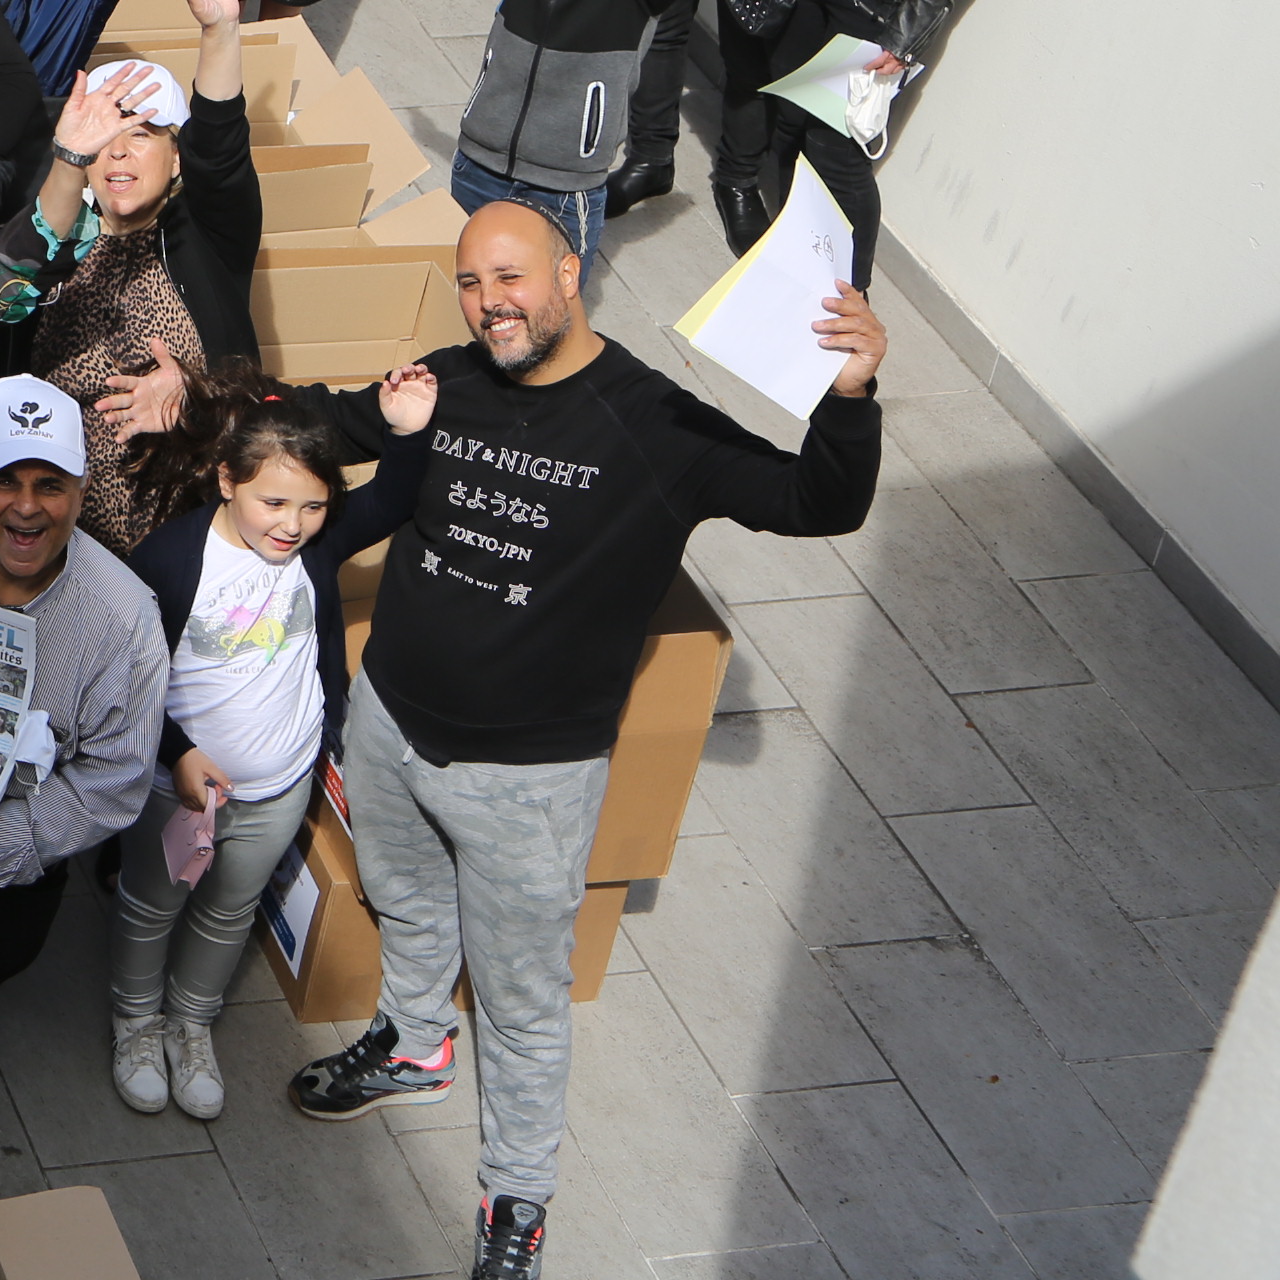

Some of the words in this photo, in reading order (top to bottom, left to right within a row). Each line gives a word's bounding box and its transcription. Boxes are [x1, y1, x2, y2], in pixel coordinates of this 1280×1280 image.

[9, 428, 27, 437] Lev
[29, 427, 54, 439] Zahav
[448, 480, 549, 529] さようなら
[447, 524, 533, 562] TOKYO-JPN
[447, 567, 464, 580] EAST
[464, 575, 474, 584] TO
[476, 579, 499, 591] WEST
[504, 583, 532, 606] 京
